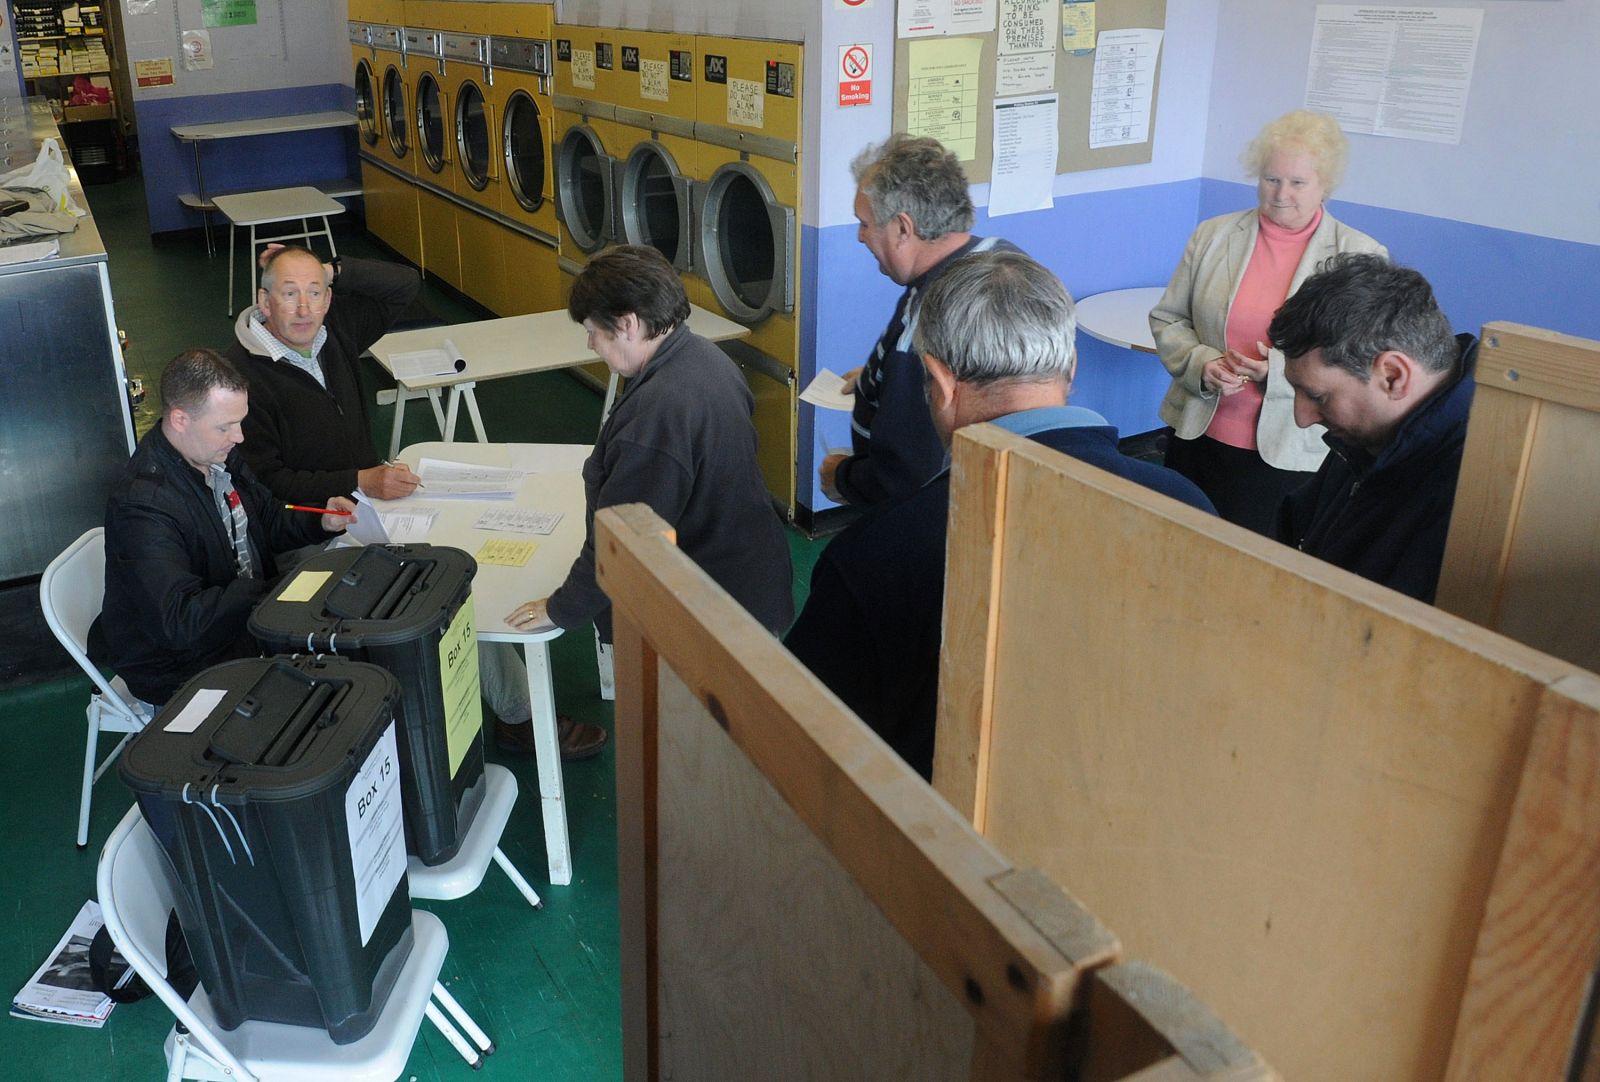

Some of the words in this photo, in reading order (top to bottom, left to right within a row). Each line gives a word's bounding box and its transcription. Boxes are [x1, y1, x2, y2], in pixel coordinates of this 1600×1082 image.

[1012, 4, 1040, 12] DRINKS
[1023, 11, 1033, 19] BE
[1003, 19, 1043, 28] CONSUMED
[1021, 26, 1044, 34] THESE
[1006, 34, 1044, 42] PREMISES
[643, 62, 664, 73] PLEASE
[732, 80, 758, 95] PLEASE
[730, 90, 737, 99] DO
[841, 93, 870, 101] Smoking
[736, 101, 755, 111] SLAM
[729, 107, 739, 117] THE
[743, 111, 763, 121] DOORS
[447, 640, 461, 669] Box
[463, 621, 471, 642] 15
[358, 780, 378, 819] Box
[380, 756, 391, 781] 15
